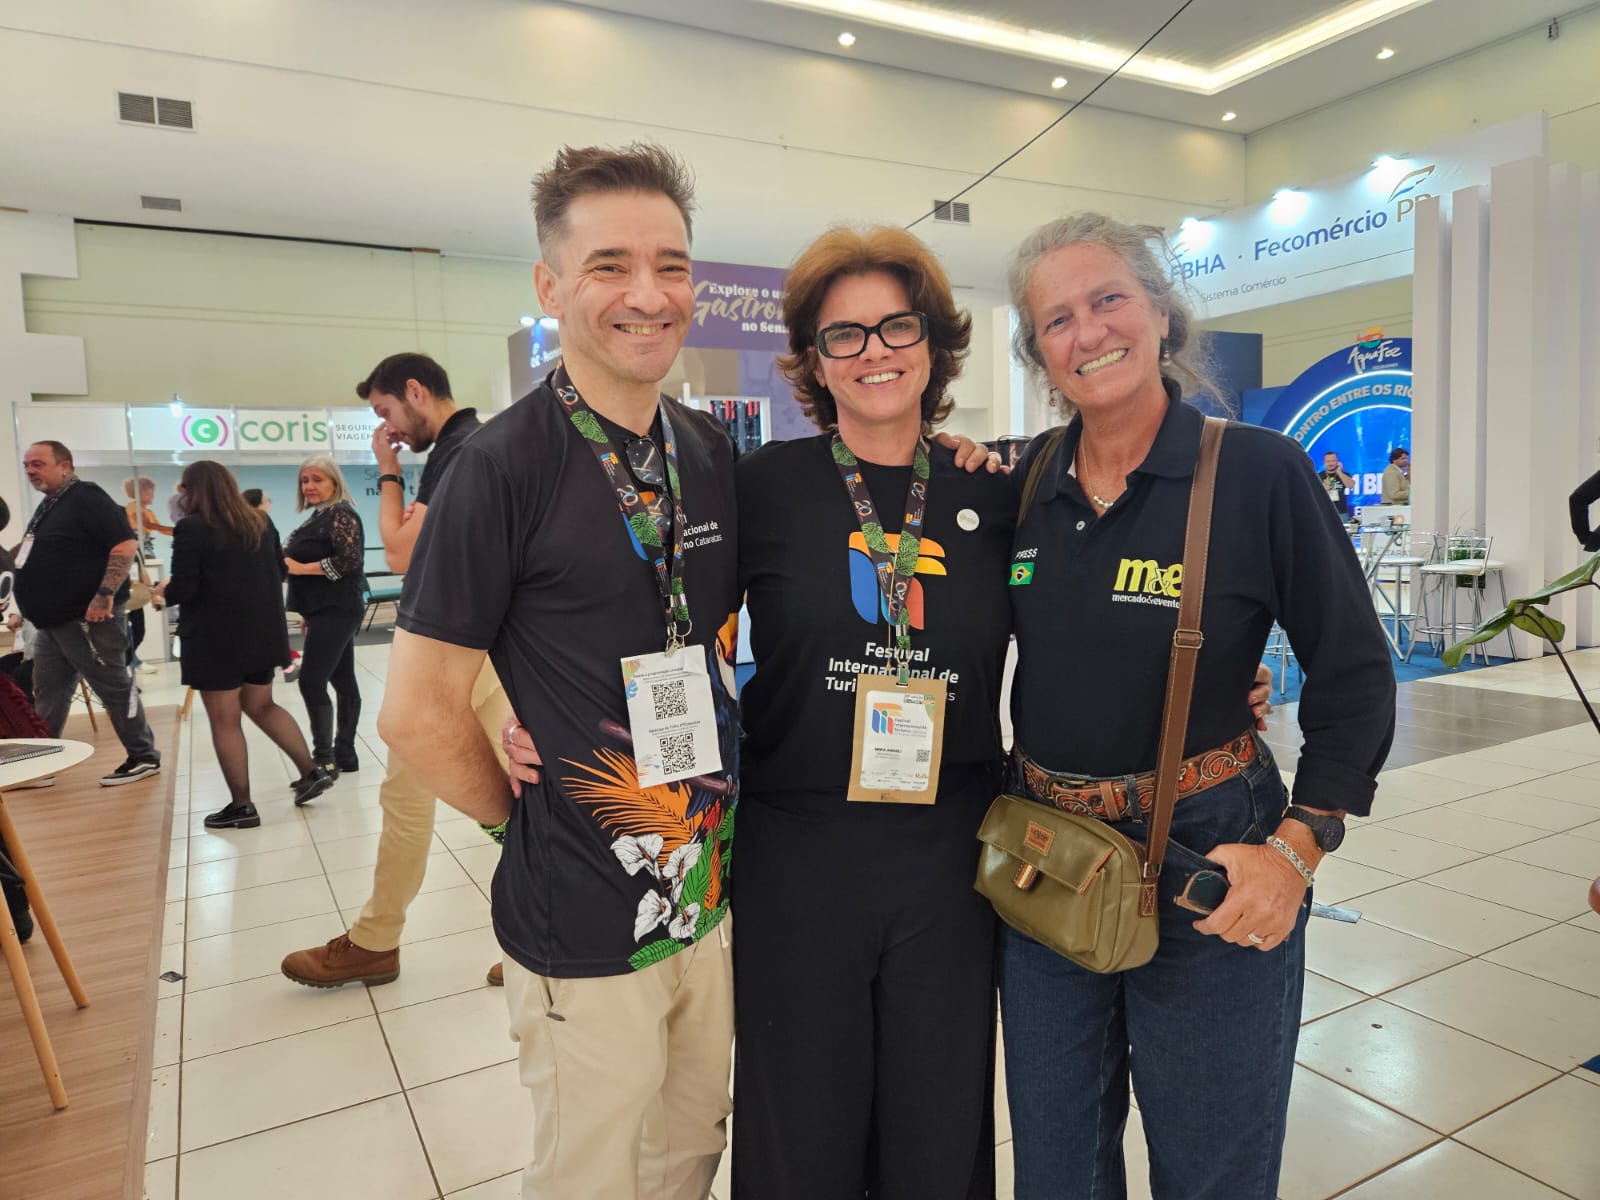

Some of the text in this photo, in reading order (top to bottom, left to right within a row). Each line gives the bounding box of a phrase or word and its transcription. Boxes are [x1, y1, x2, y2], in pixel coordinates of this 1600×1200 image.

[1254, 210, 1388, 261] Fecomércio
[709, 283, 759, 298] Explore
[761, 288, 770, 298] o
[1240, 277, 1288, 294] Comércio
[741, 321, 757, 332] no
[1329, 385, 1371, 410] ENTRE
[1372, 383, 1391, 396] OS
[240, 414, 328, 443] coris
[710, 520, 719, 530] de
[683, 534, 722, 550] no Cataratas
[865, 641, 930, 662] Festival
[939, 669, 959, 684] de
